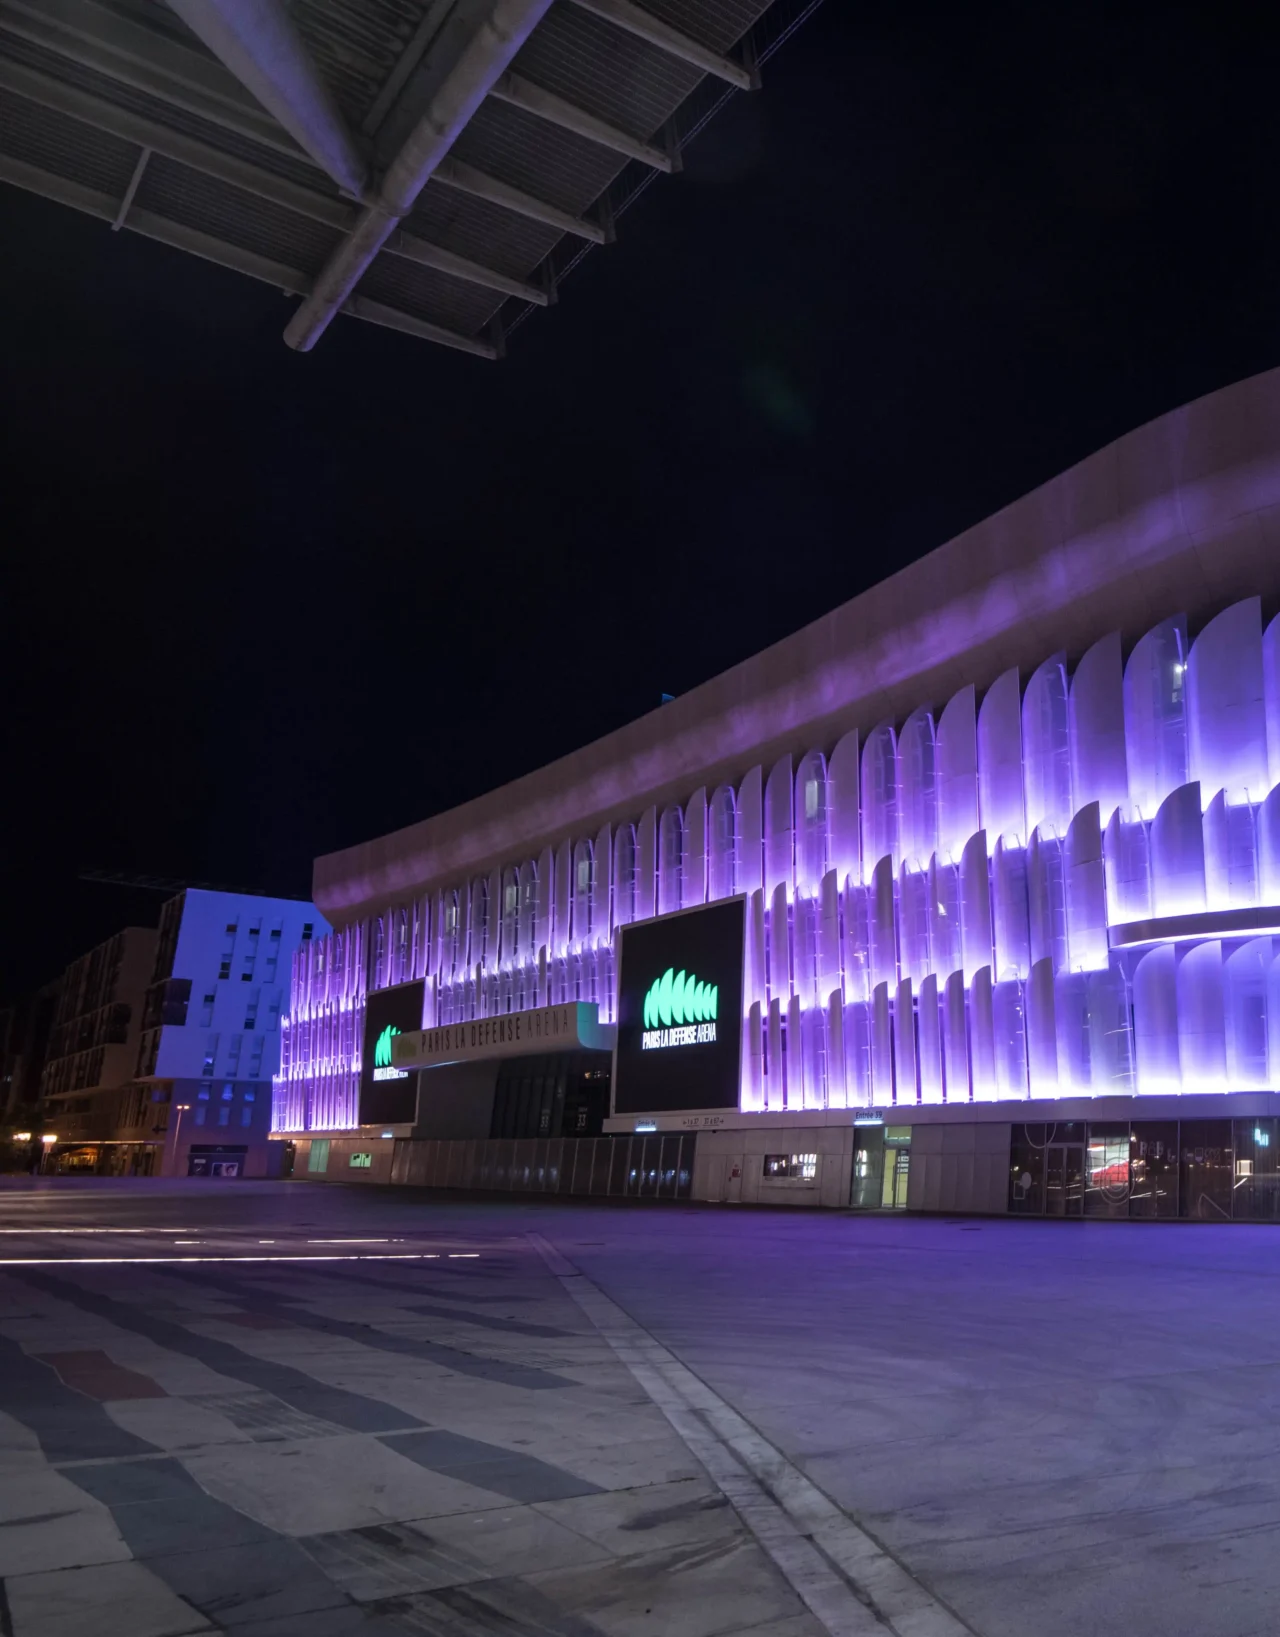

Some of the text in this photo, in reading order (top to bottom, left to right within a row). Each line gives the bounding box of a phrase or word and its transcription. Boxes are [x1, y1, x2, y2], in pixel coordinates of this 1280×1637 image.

[422, 1009, 569, 1053] PARIS LA DEFENSE ARENA
[642, 1022, 717, 1050] PARIS LA DEFENSE ARENA
[855, 1111, 874, 1119] Entrée
